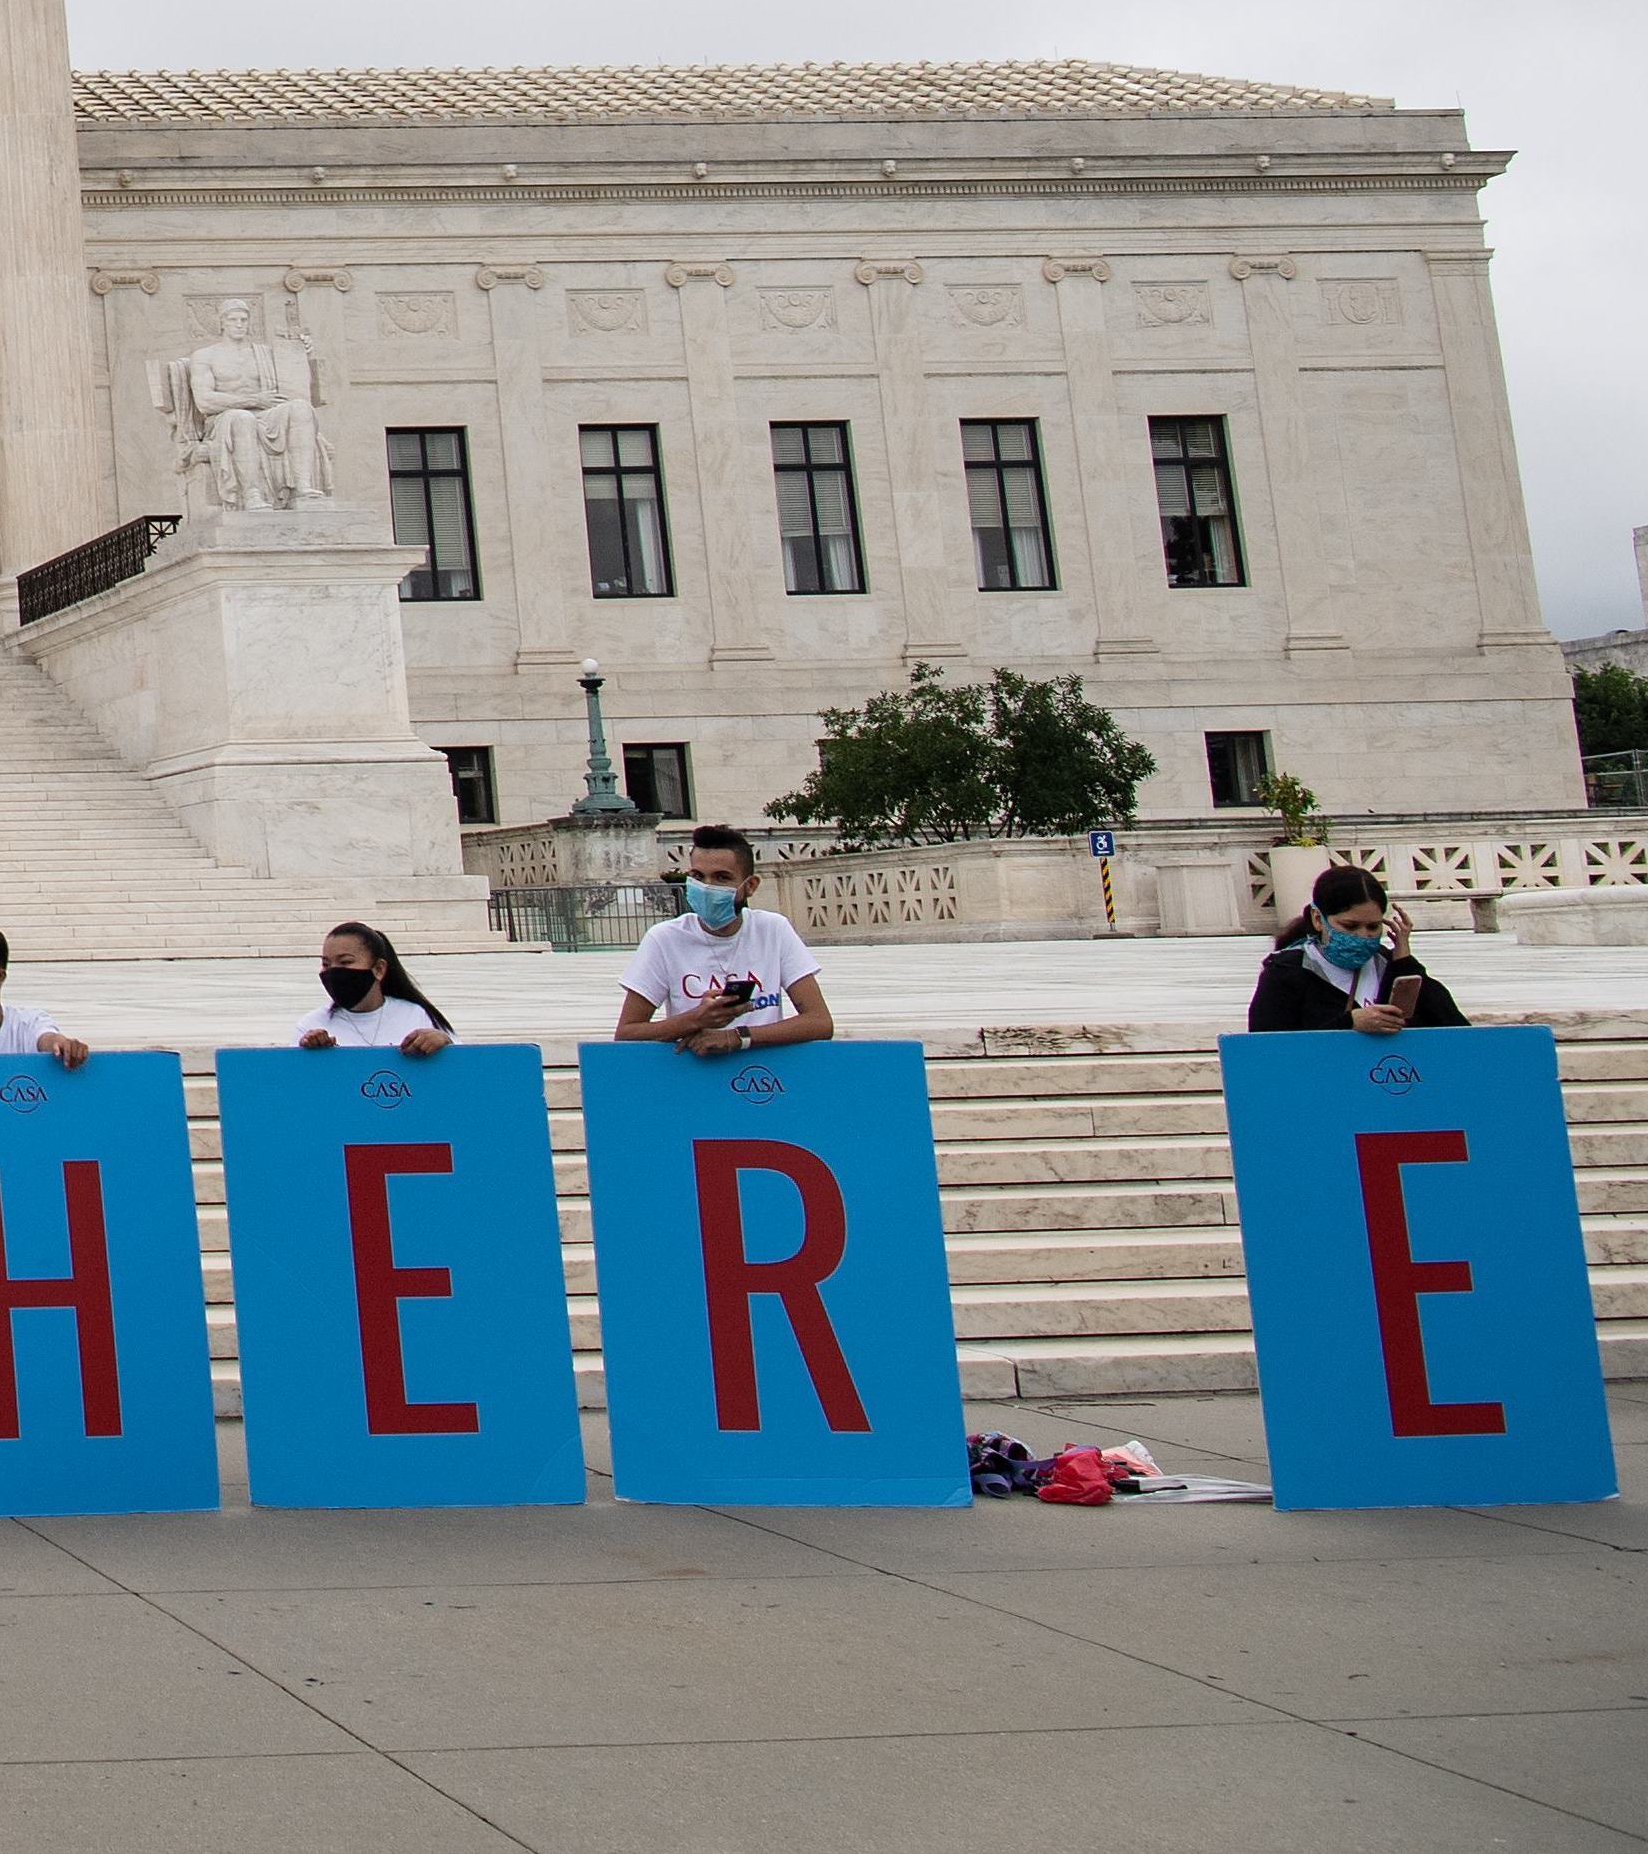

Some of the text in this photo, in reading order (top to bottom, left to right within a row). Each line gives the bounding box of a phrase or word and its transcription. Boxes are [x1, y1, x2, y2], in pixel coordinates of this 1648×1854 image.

[1369, 1065, 1422, 1084] CASA
[360, 1081, 413, 1099] CASA
[730, 1076, 785, 1093] CASA
